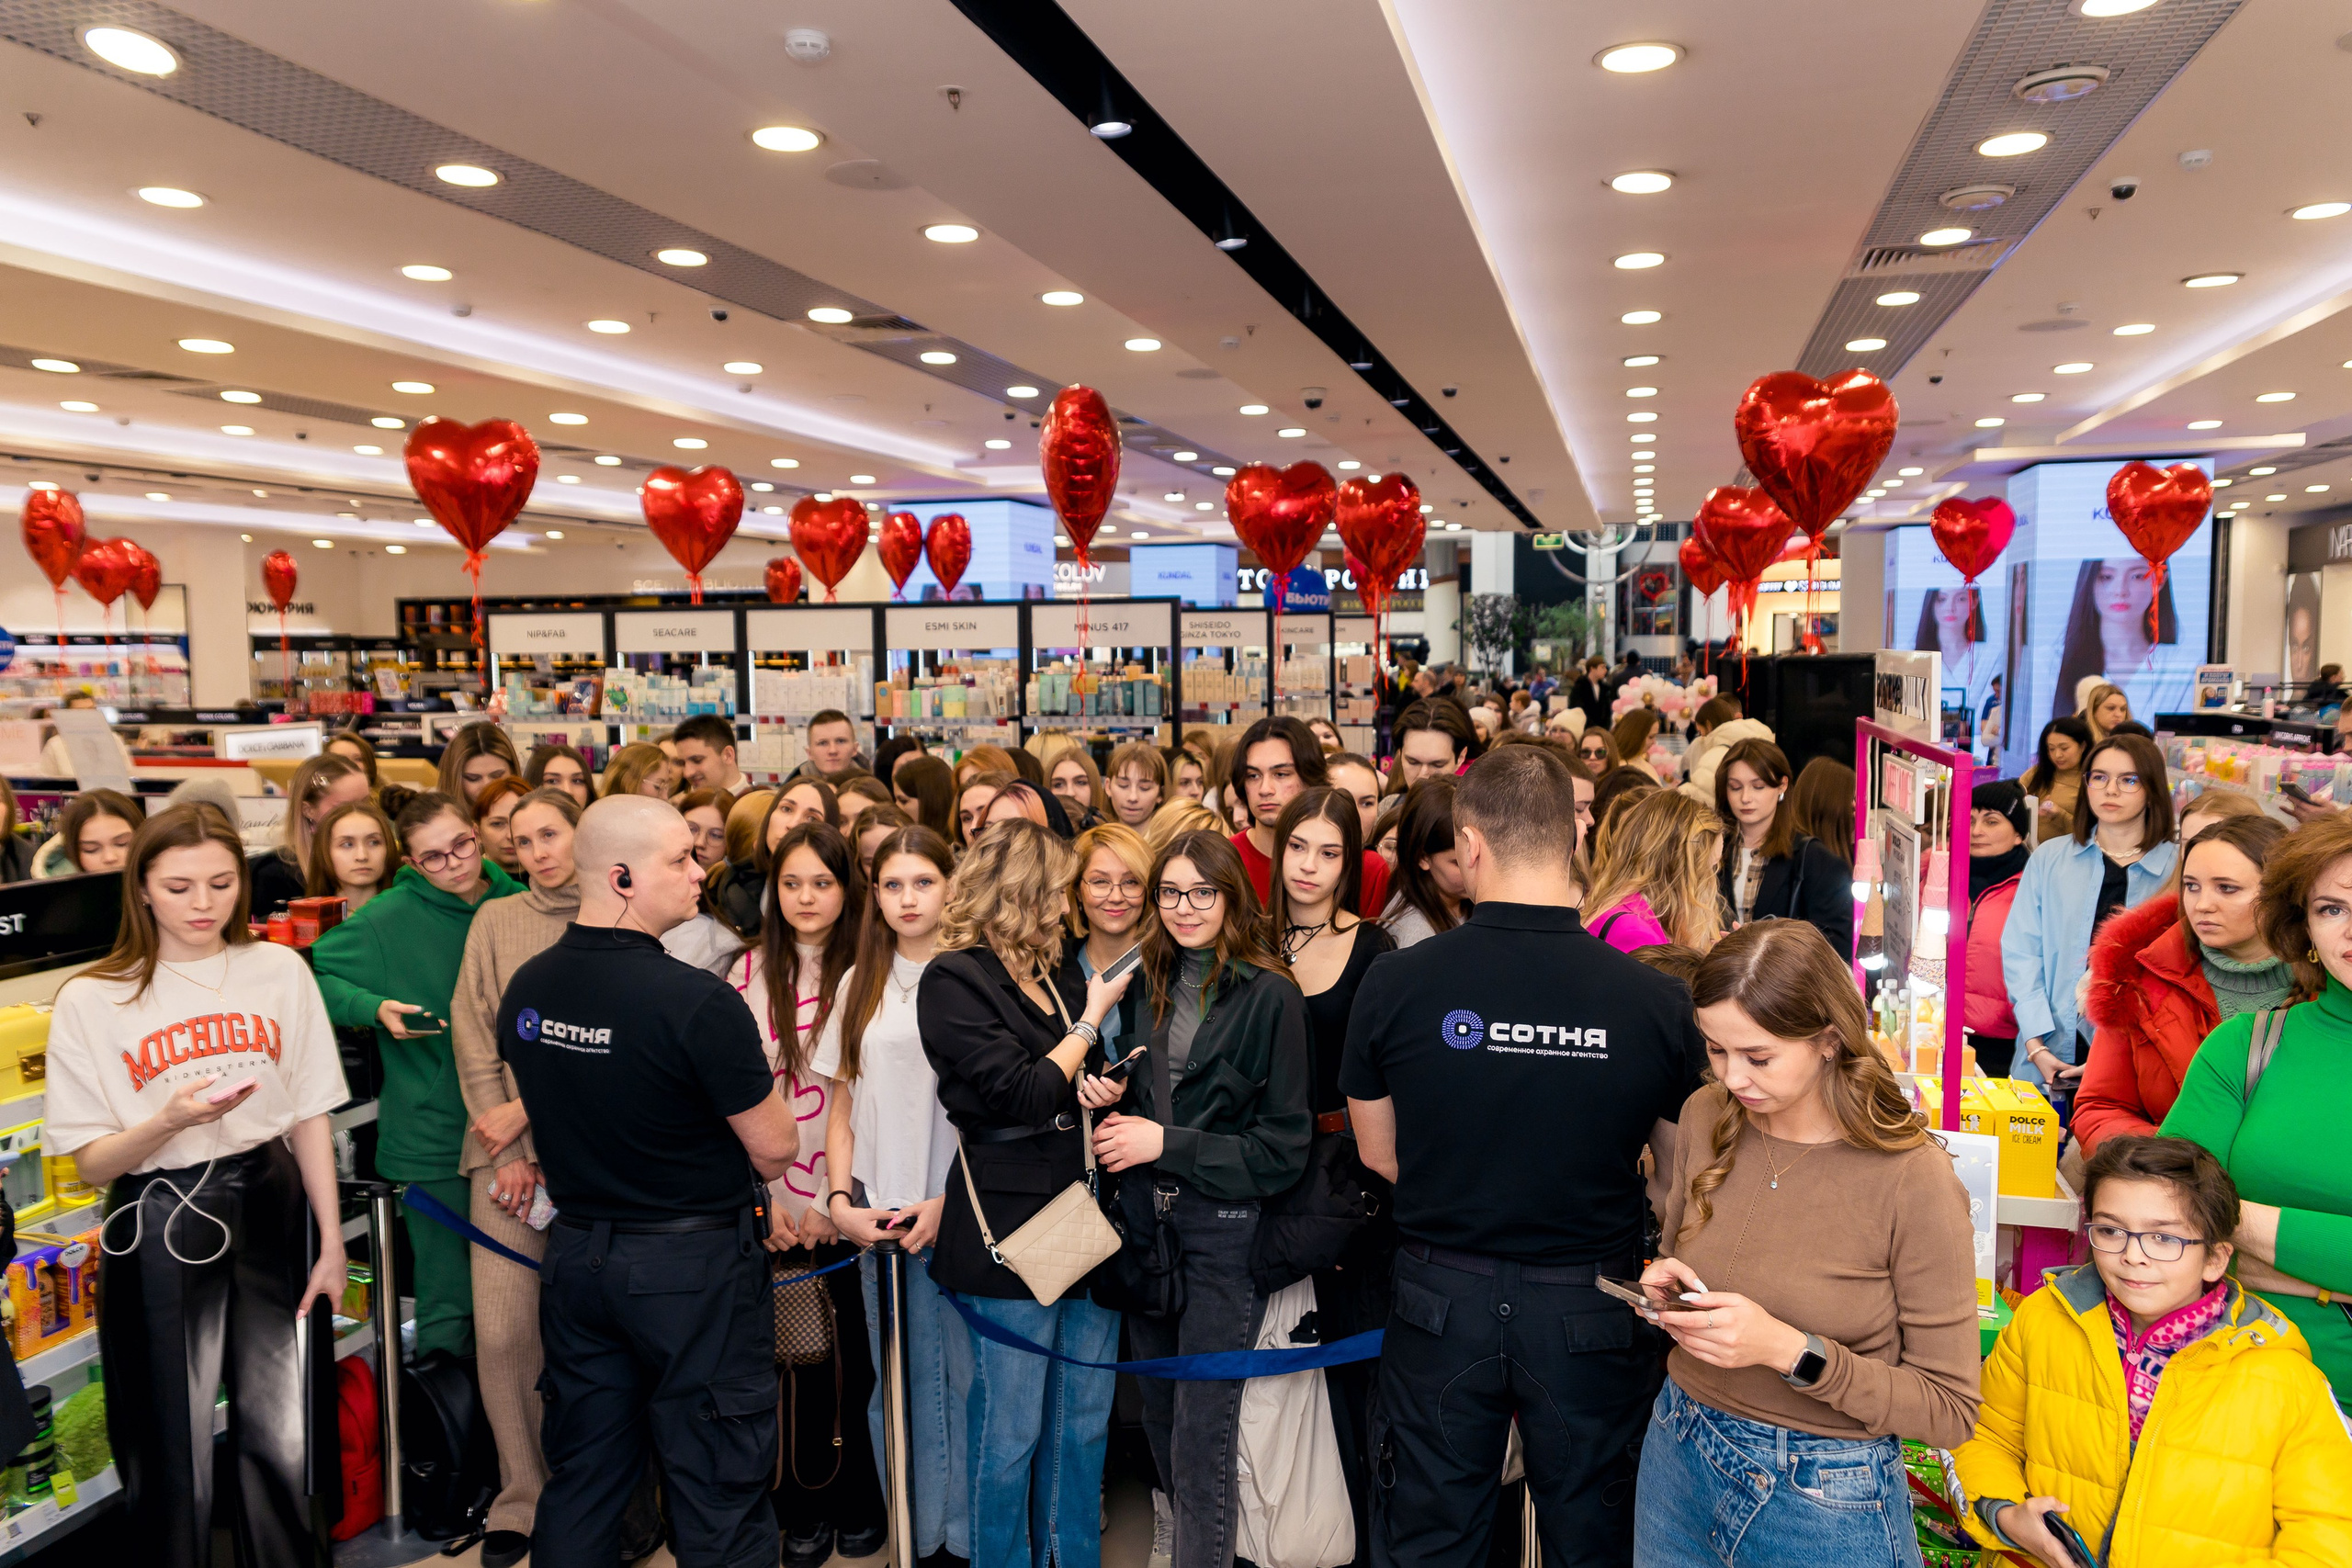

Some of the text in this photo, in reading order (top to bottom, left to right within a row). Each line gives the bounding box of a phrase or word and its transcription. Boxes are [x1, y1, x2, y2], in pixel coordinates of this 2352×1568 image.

[247, 602, 314, 615] ЮМРИЯ
[925, 621, 977, 631] ESMI SKIN
[1074, 622, 1129, 632] MINUS 417
[1189, 621, 1231, 629] SHISEIDO
[526, 629, 566, 638] NIP&FAB
[652, 627, 696, 637] SEACARE
[1180, 631, 1207, 639] GINZA
[541, 1019, 611, 1044] СОТНЯ
[1489, 1022, 1607, 1048] СОТНЯ
[120, 1012, 282, 1092] MICHIGAN
[1487, 1044, 1609, 1059] современное охранное агентство
[164, 1059, 266, 1083] MIDWESTERN
[1961, 1122, 1980, 1132] LK
[2009, 1122, 2045, 1135] MILK
[2022, 1136, 2041, 1145] CREAM
